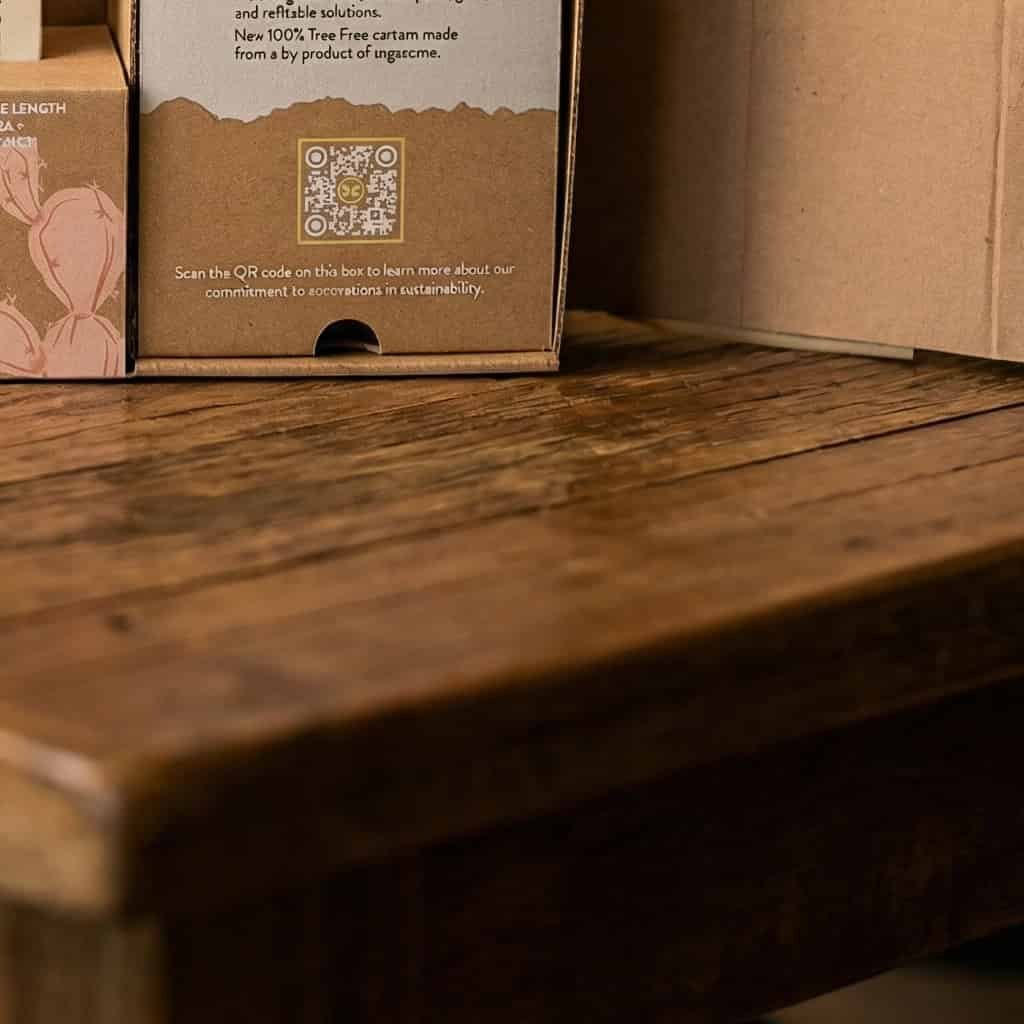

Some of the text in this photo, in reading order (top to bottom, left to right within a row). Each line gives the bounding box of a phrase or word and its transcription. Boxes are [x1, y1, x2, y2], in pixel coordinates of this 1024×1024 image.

[235, 7, 258, 19] and
[321, 5, 382, 18] solutions.
[268, 28, 304, 41] 100%
[308, 28, 336, 40] Tree
[339, 28, 368, 40] Free
[423, 28, 458, 40] made
[234, 47, 266, 60] from
[271, 50, 277, 60] a
[281, 47, 298, 63] by
[302, 47, 353, 64] product
[356, 47, 372, 59] of
[12, 102, 66, 115] LENGTH
[175, 267, 206, 280] Scan
[233, 265, 258, 282] QR
[262, 266, 292, 278] code
[295, 268, 312, 277] on
[341, 264, 364, 277] box
[368, 266, 380, 276] to
[383, 264, 415, 276] learn
[418, 267, 451, 276] more
[455, 263, 489, 275] about
[494, 265, 515, 275] our
[205, 285, 288, 298] commitment
[292, 286, 304, 297] to
[386, 283, 397, 295] in
